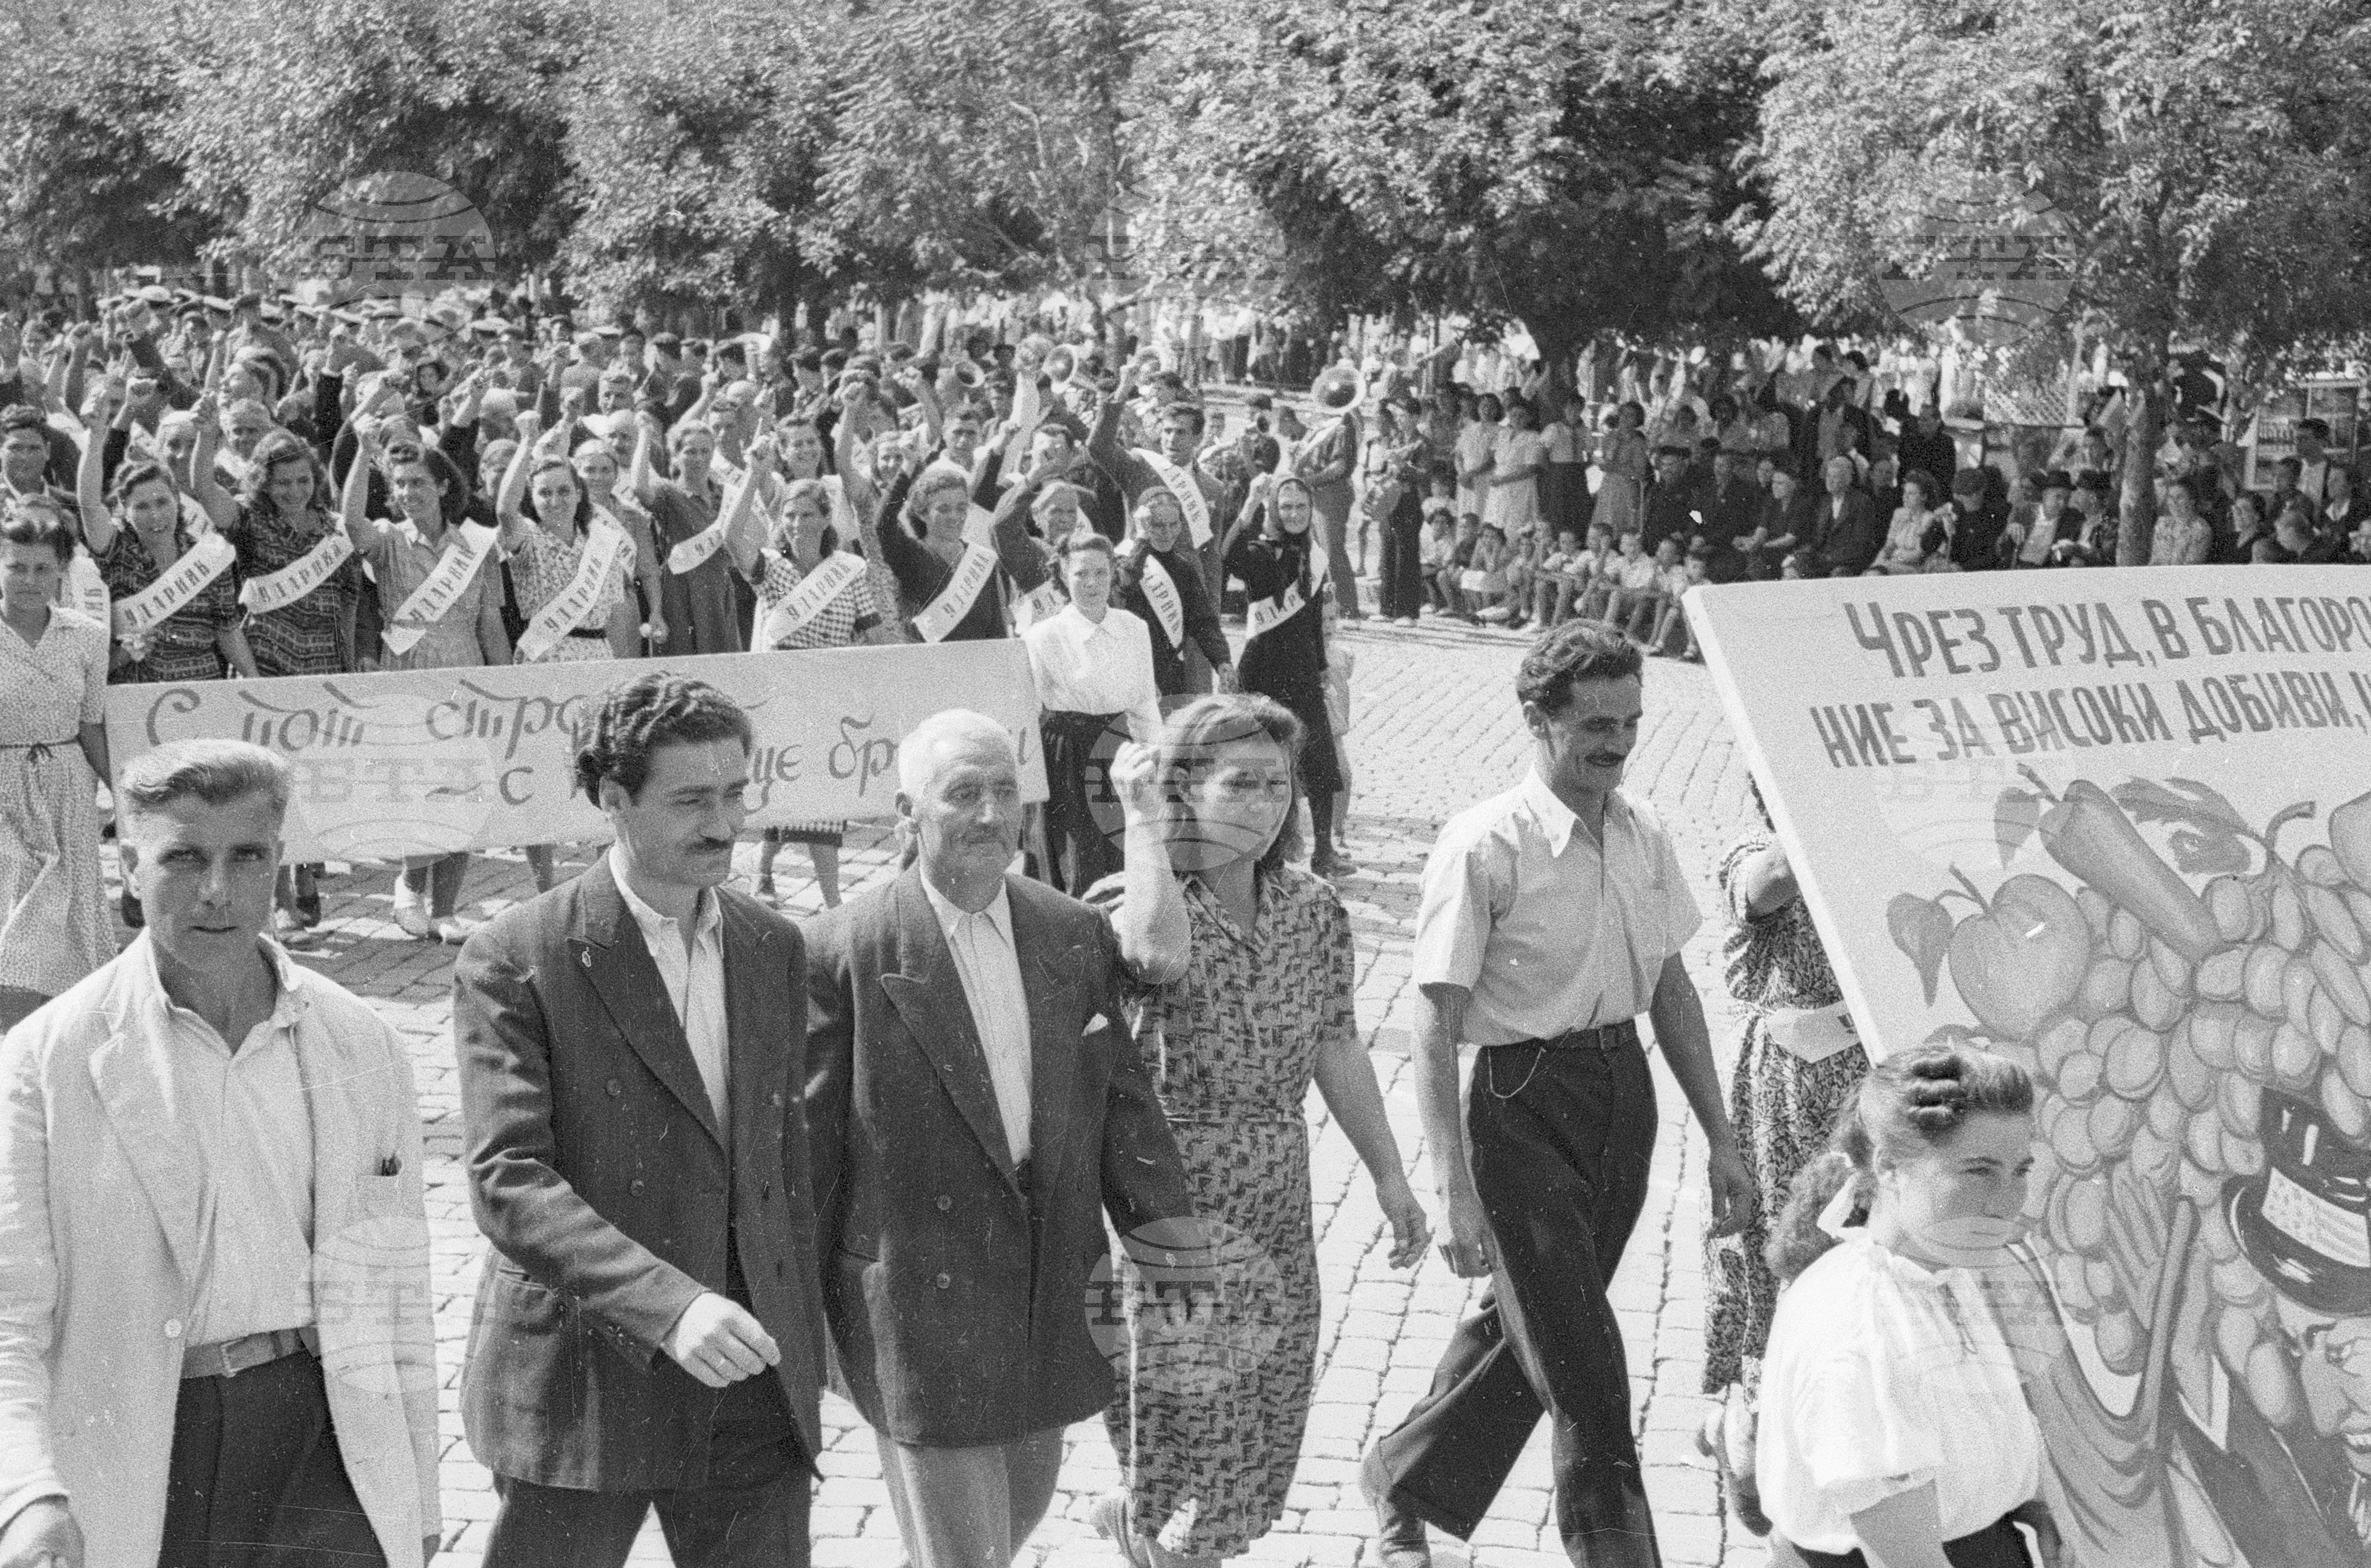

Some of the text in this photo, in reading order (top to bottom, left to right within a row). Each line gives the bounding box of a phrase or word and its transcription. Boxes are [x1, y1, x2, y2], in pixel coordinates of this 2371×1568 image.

[1997, 602, 2156, 668] ТРУД,
[2141, 599, 2190, 659] В
[2185, 596, 2371, 655] БЛАГОРО
[1810, 703, 1917, 768] НИЕ
[1911, 697, 1996, 761] ЗА
[1987, 682, 2174, 755] ВИСОКИ
[2175, 671, 2367, 745] ДОБИВИ,
